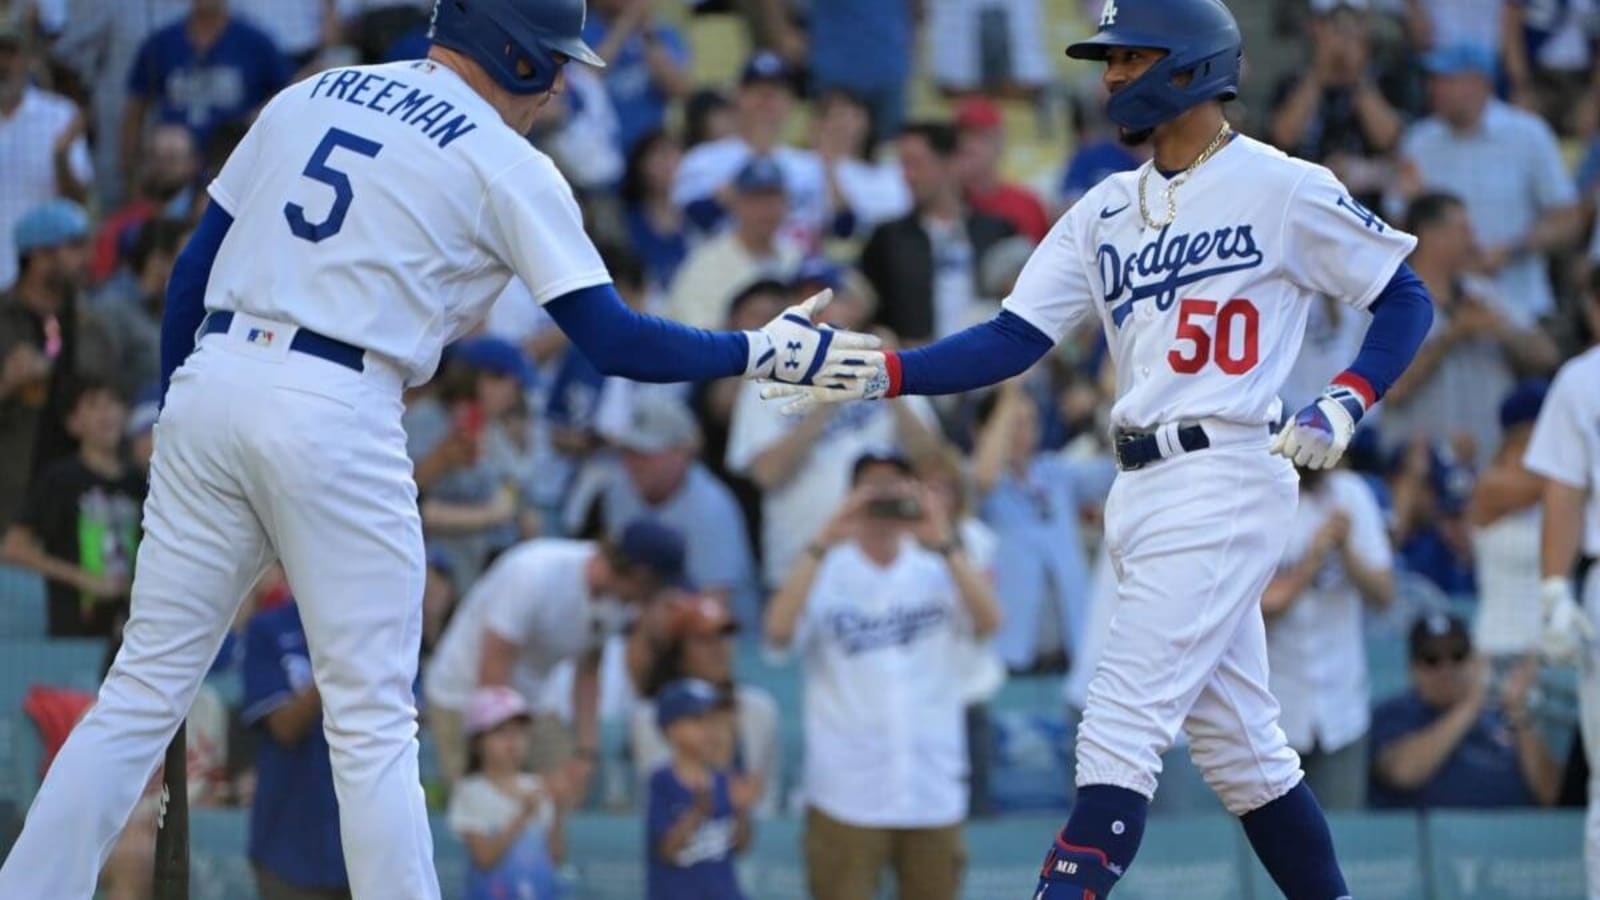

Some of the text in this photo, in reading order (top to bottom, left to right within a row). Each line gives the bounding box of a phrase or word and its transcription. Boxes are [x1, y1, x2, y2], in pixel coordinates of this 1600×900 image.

[310, 69, 478, 149] FREEMAN
[284, 126, 384, 244] 5
[1097, 223, 1264, 320] Dodgers
[1167, 298, 1260, 375] 50
[1055, 859, 1078, 875] MB
